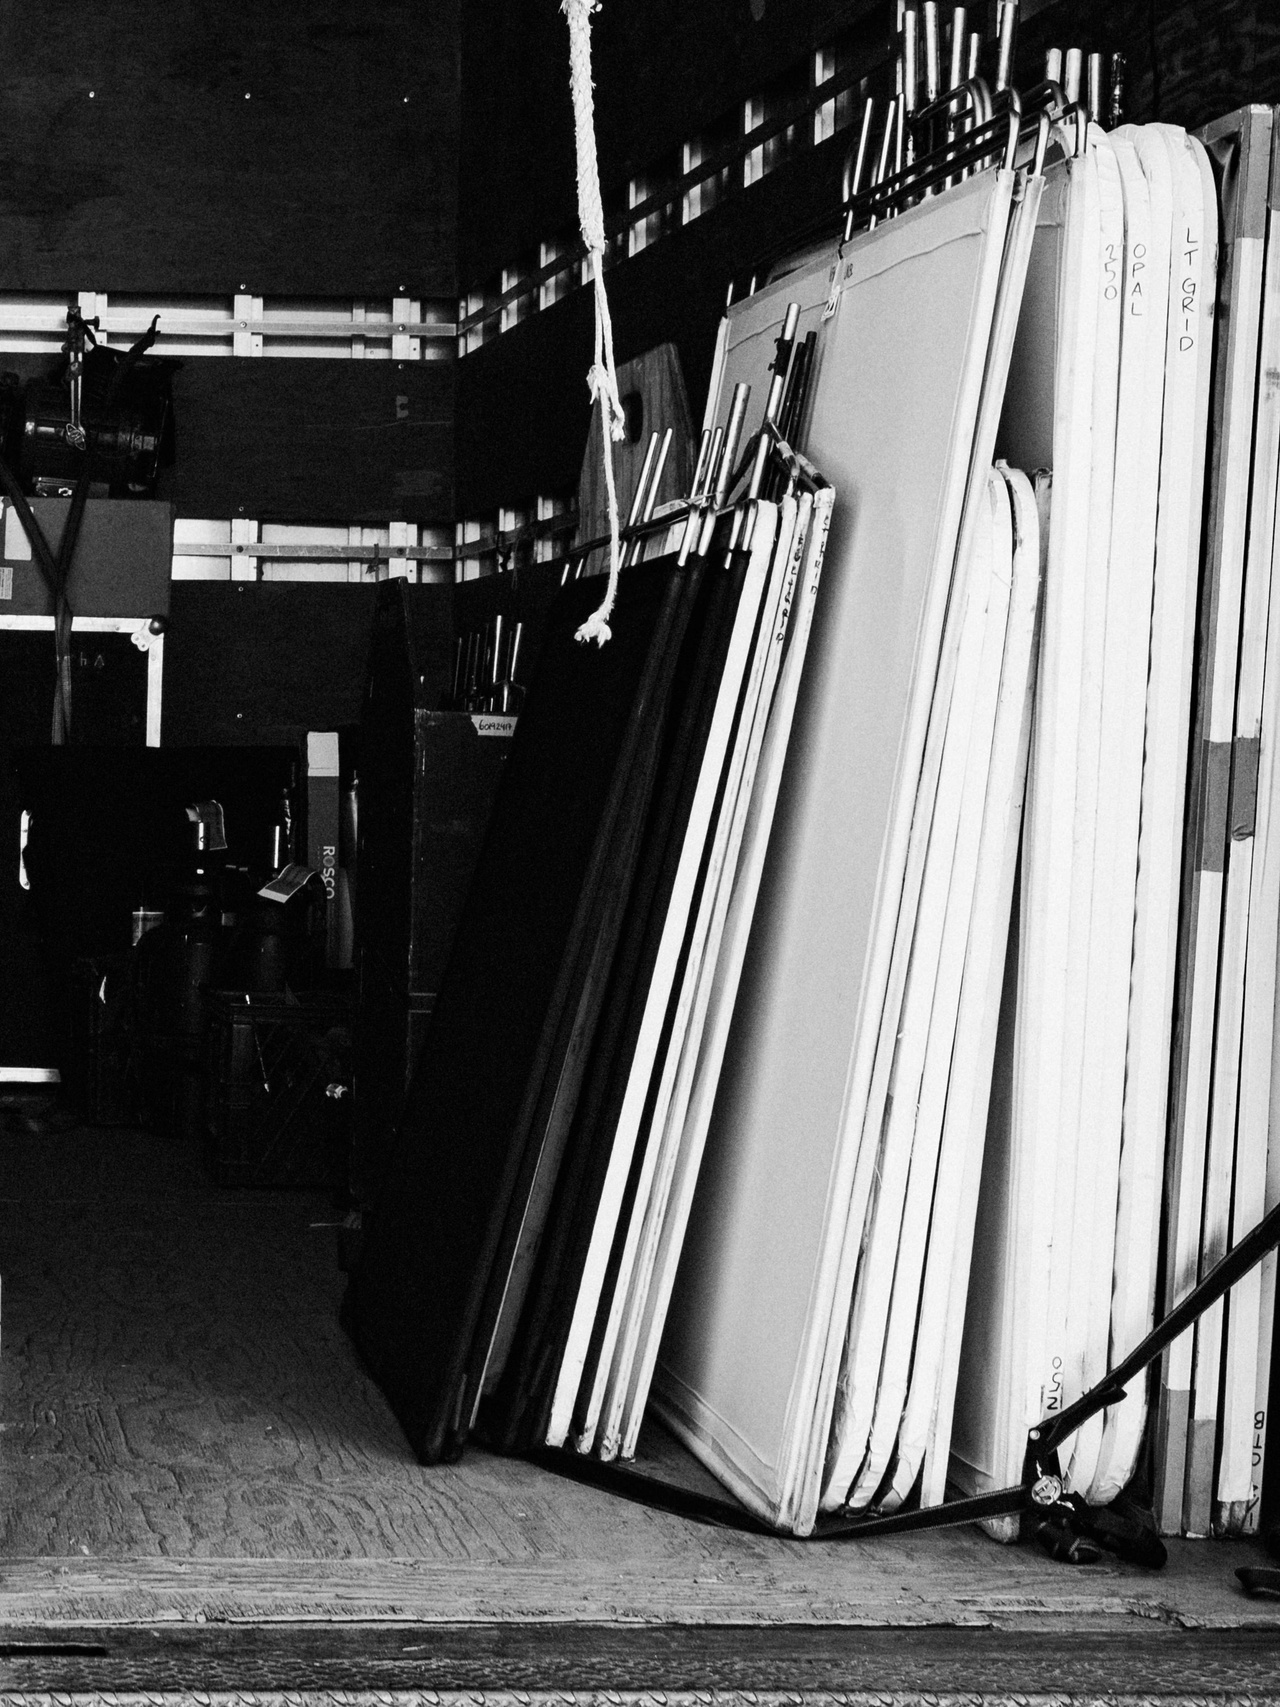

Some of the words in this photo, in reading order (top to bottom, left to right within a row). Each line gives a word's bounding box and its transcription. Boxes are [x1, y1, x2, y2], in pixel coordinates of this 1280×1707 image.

[1130, 243, 1147, 316] OPAL
[1179, 277, 1196, 352] GRID
[322, 845, 336, 899] ROSCO
